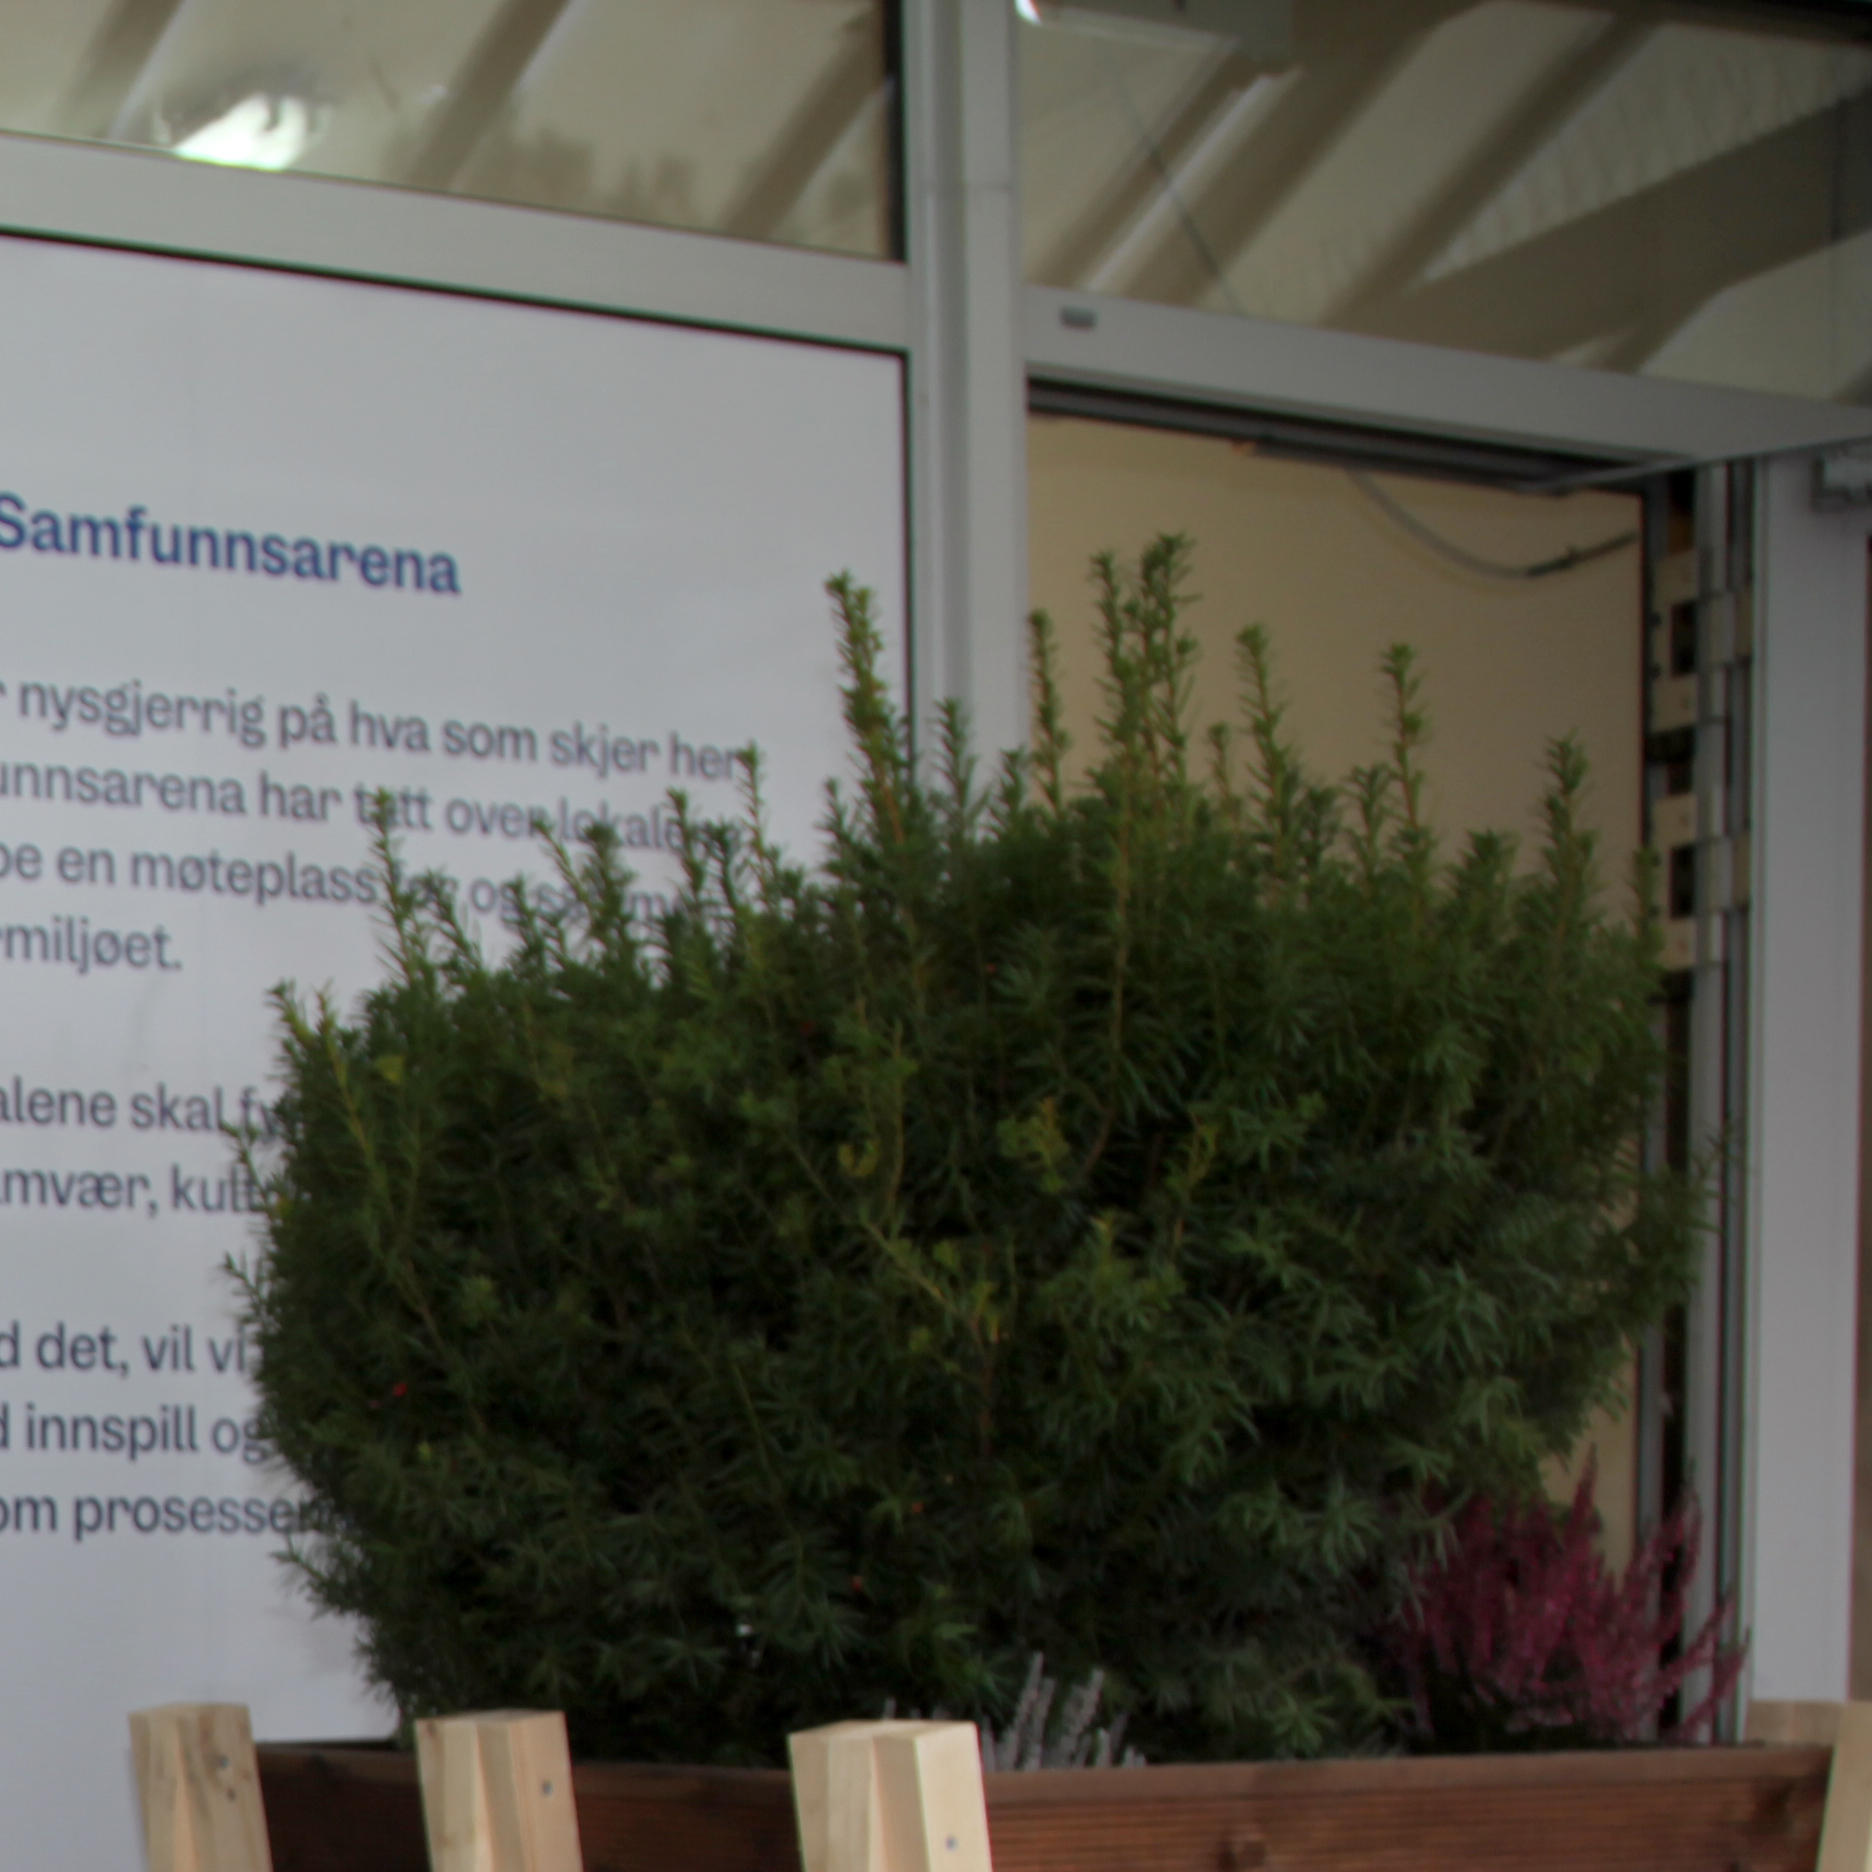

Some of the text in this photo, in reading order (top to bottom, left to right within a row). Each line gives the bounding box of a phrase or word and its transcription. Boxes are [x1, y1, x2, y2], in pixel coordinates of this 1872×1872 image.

[20, 678, 268, 750] nysgjerrig
[278, 692, 337, 748] på
[350, 699, 432, 752] hva
[444, 718, 537, 762] som
[550, 721, 660, 779] skjer
[259, 770, 343, 822] har
[58, 845, 115, 885] en
[132, 850, 378, 906] møteplass
[131, 1080, 224, 1131] skal
[36, 1321, 131, 1379] det,
[142, 1323, 196, 1372] vil
[26, 1403, 199, 1463] innspill
